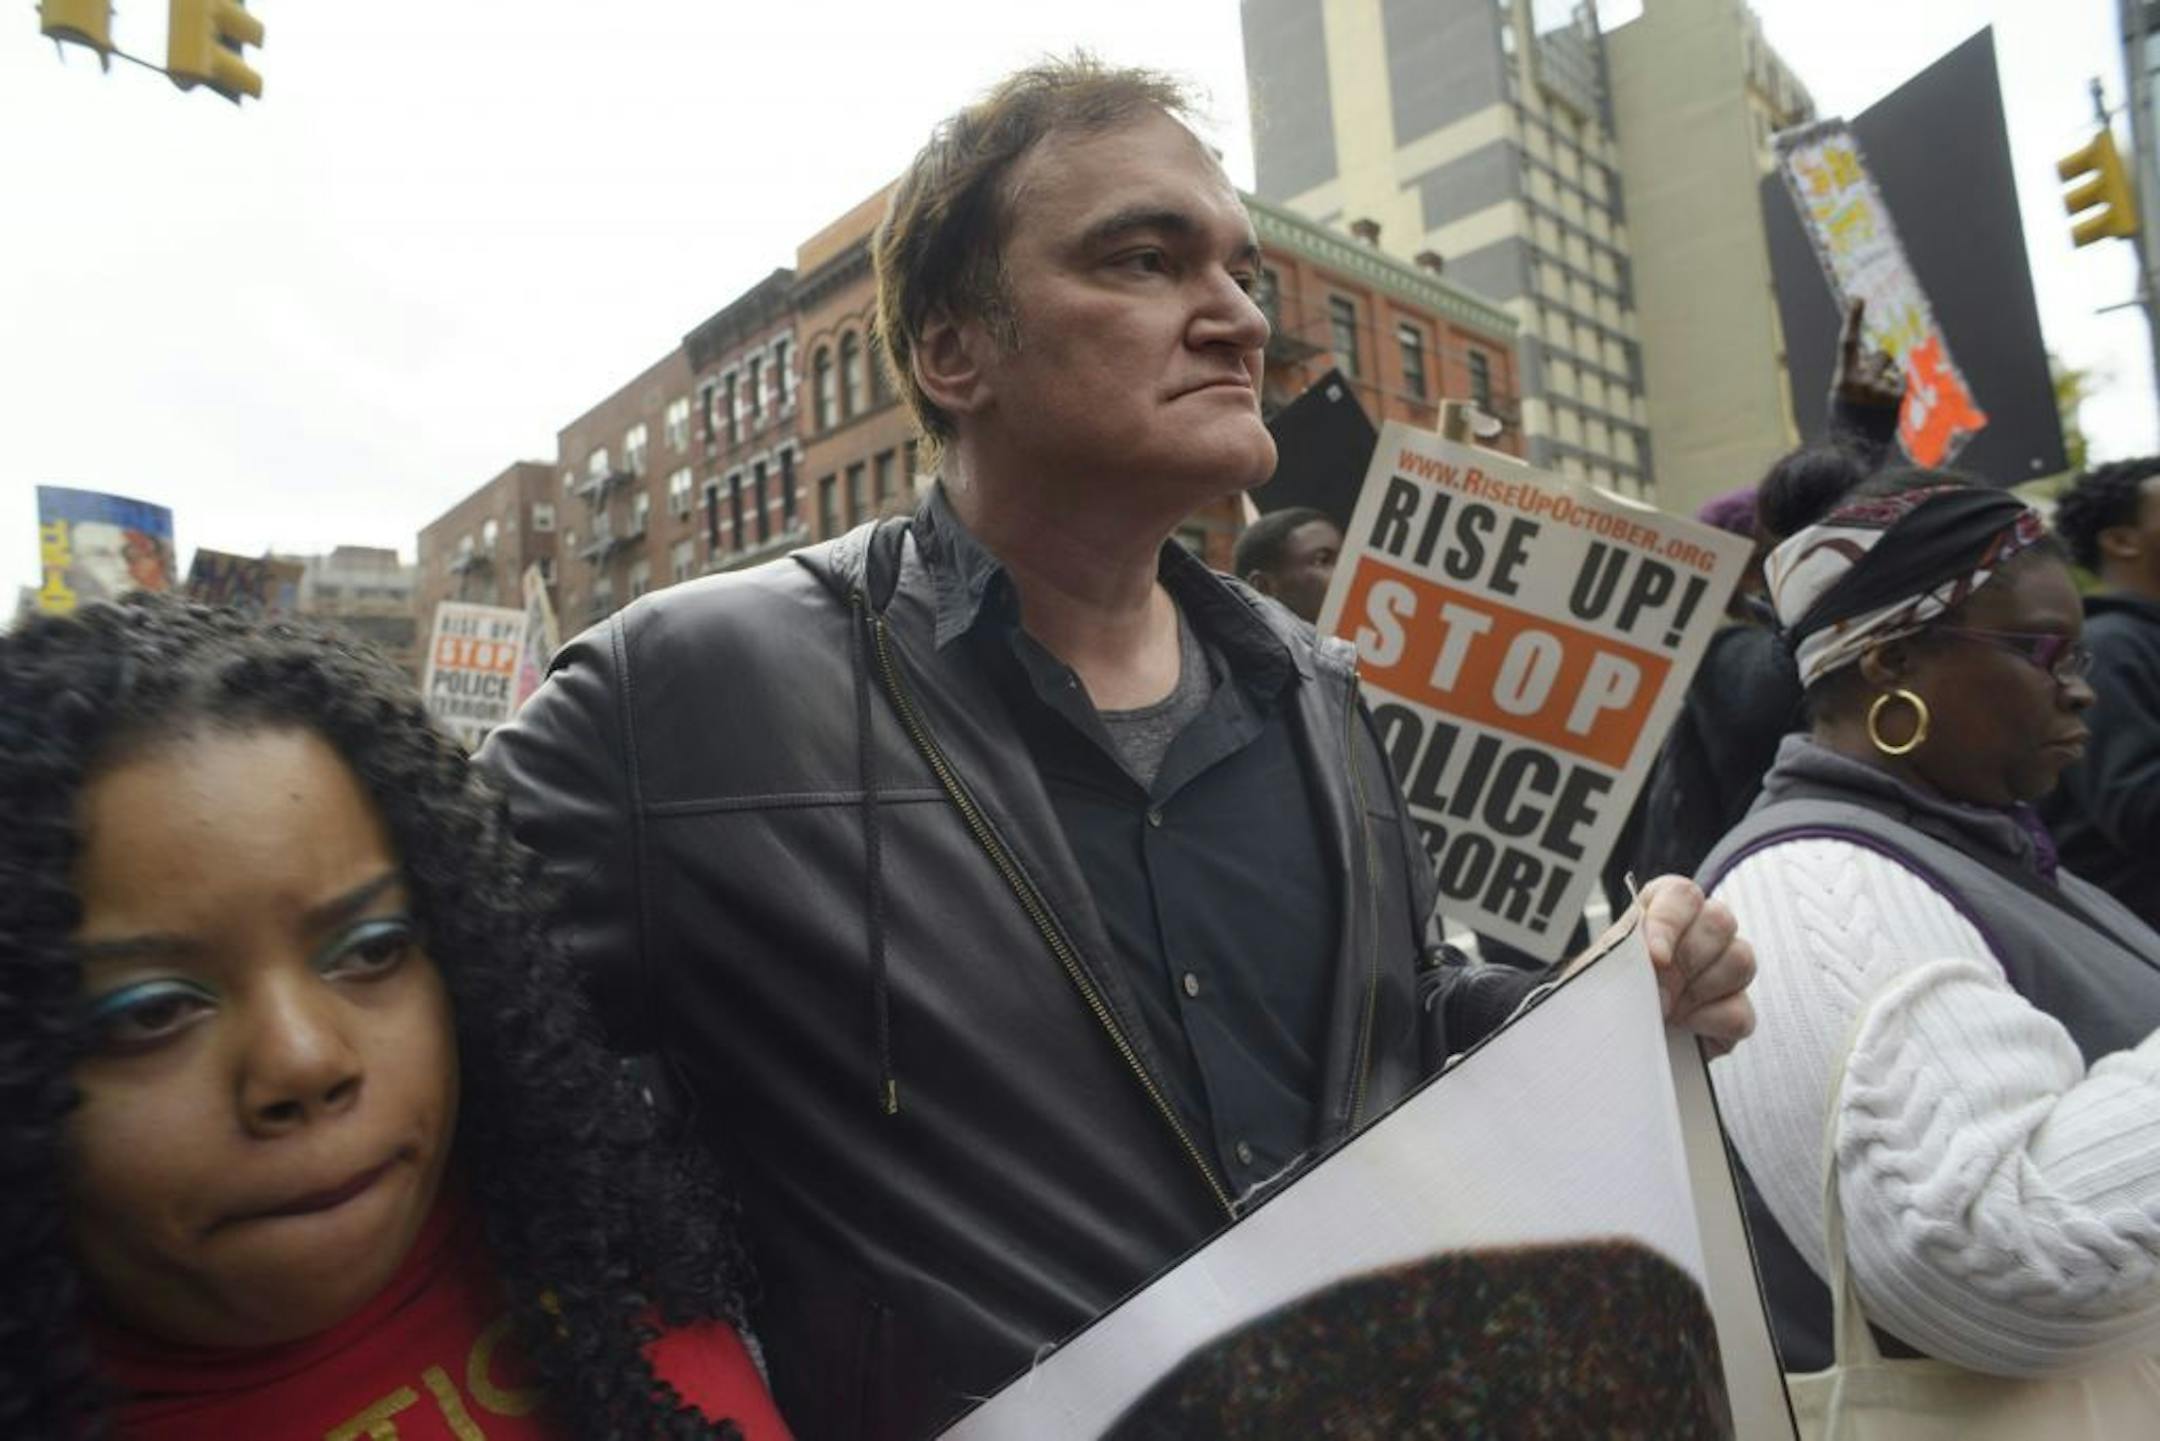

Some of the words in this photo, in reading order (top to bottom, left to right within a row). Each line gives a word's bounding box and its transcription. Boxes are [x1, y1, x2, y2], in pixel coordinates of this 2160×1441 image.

[1369, 476, 1540, 597] RISE
[1569, 541, 1709, 649] UP!
[433, 670, 510, 699] POLICE
[440, 639, 513, 671] STOP
[1356, 579, 1642, 737] STOP
[1373, 703, 1614, 861] OLICE
[1412, 819, 1573, 934] ROR!
